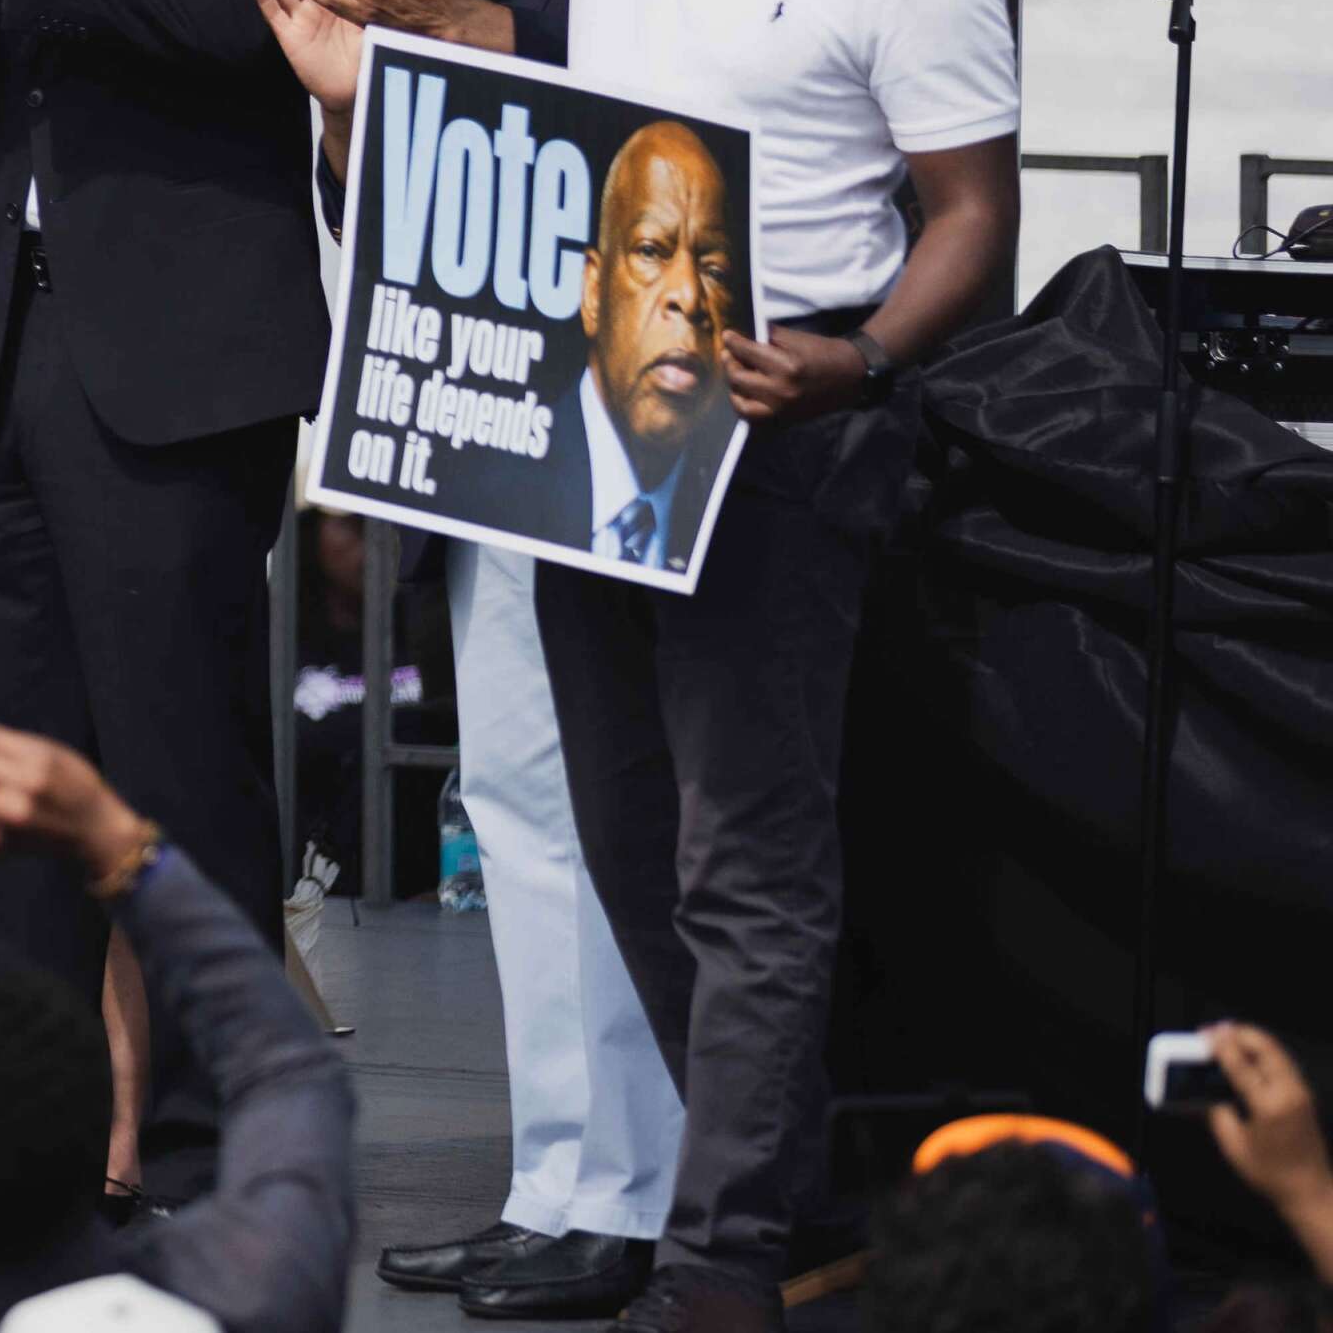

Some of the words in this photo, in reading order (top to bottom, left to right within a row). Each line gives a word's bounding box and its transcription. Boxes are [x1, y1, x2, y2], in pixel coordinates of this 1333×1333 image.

[382, 66, 592, 332] Vote
[366, 283, 442, 364] like
[445, 313, 544, 385] your
[356, 353, 414, 427] life
[415, 369, 554, 459] depends
[347, 429, 396, 485] on
[398, 430, 437, 496] it.
